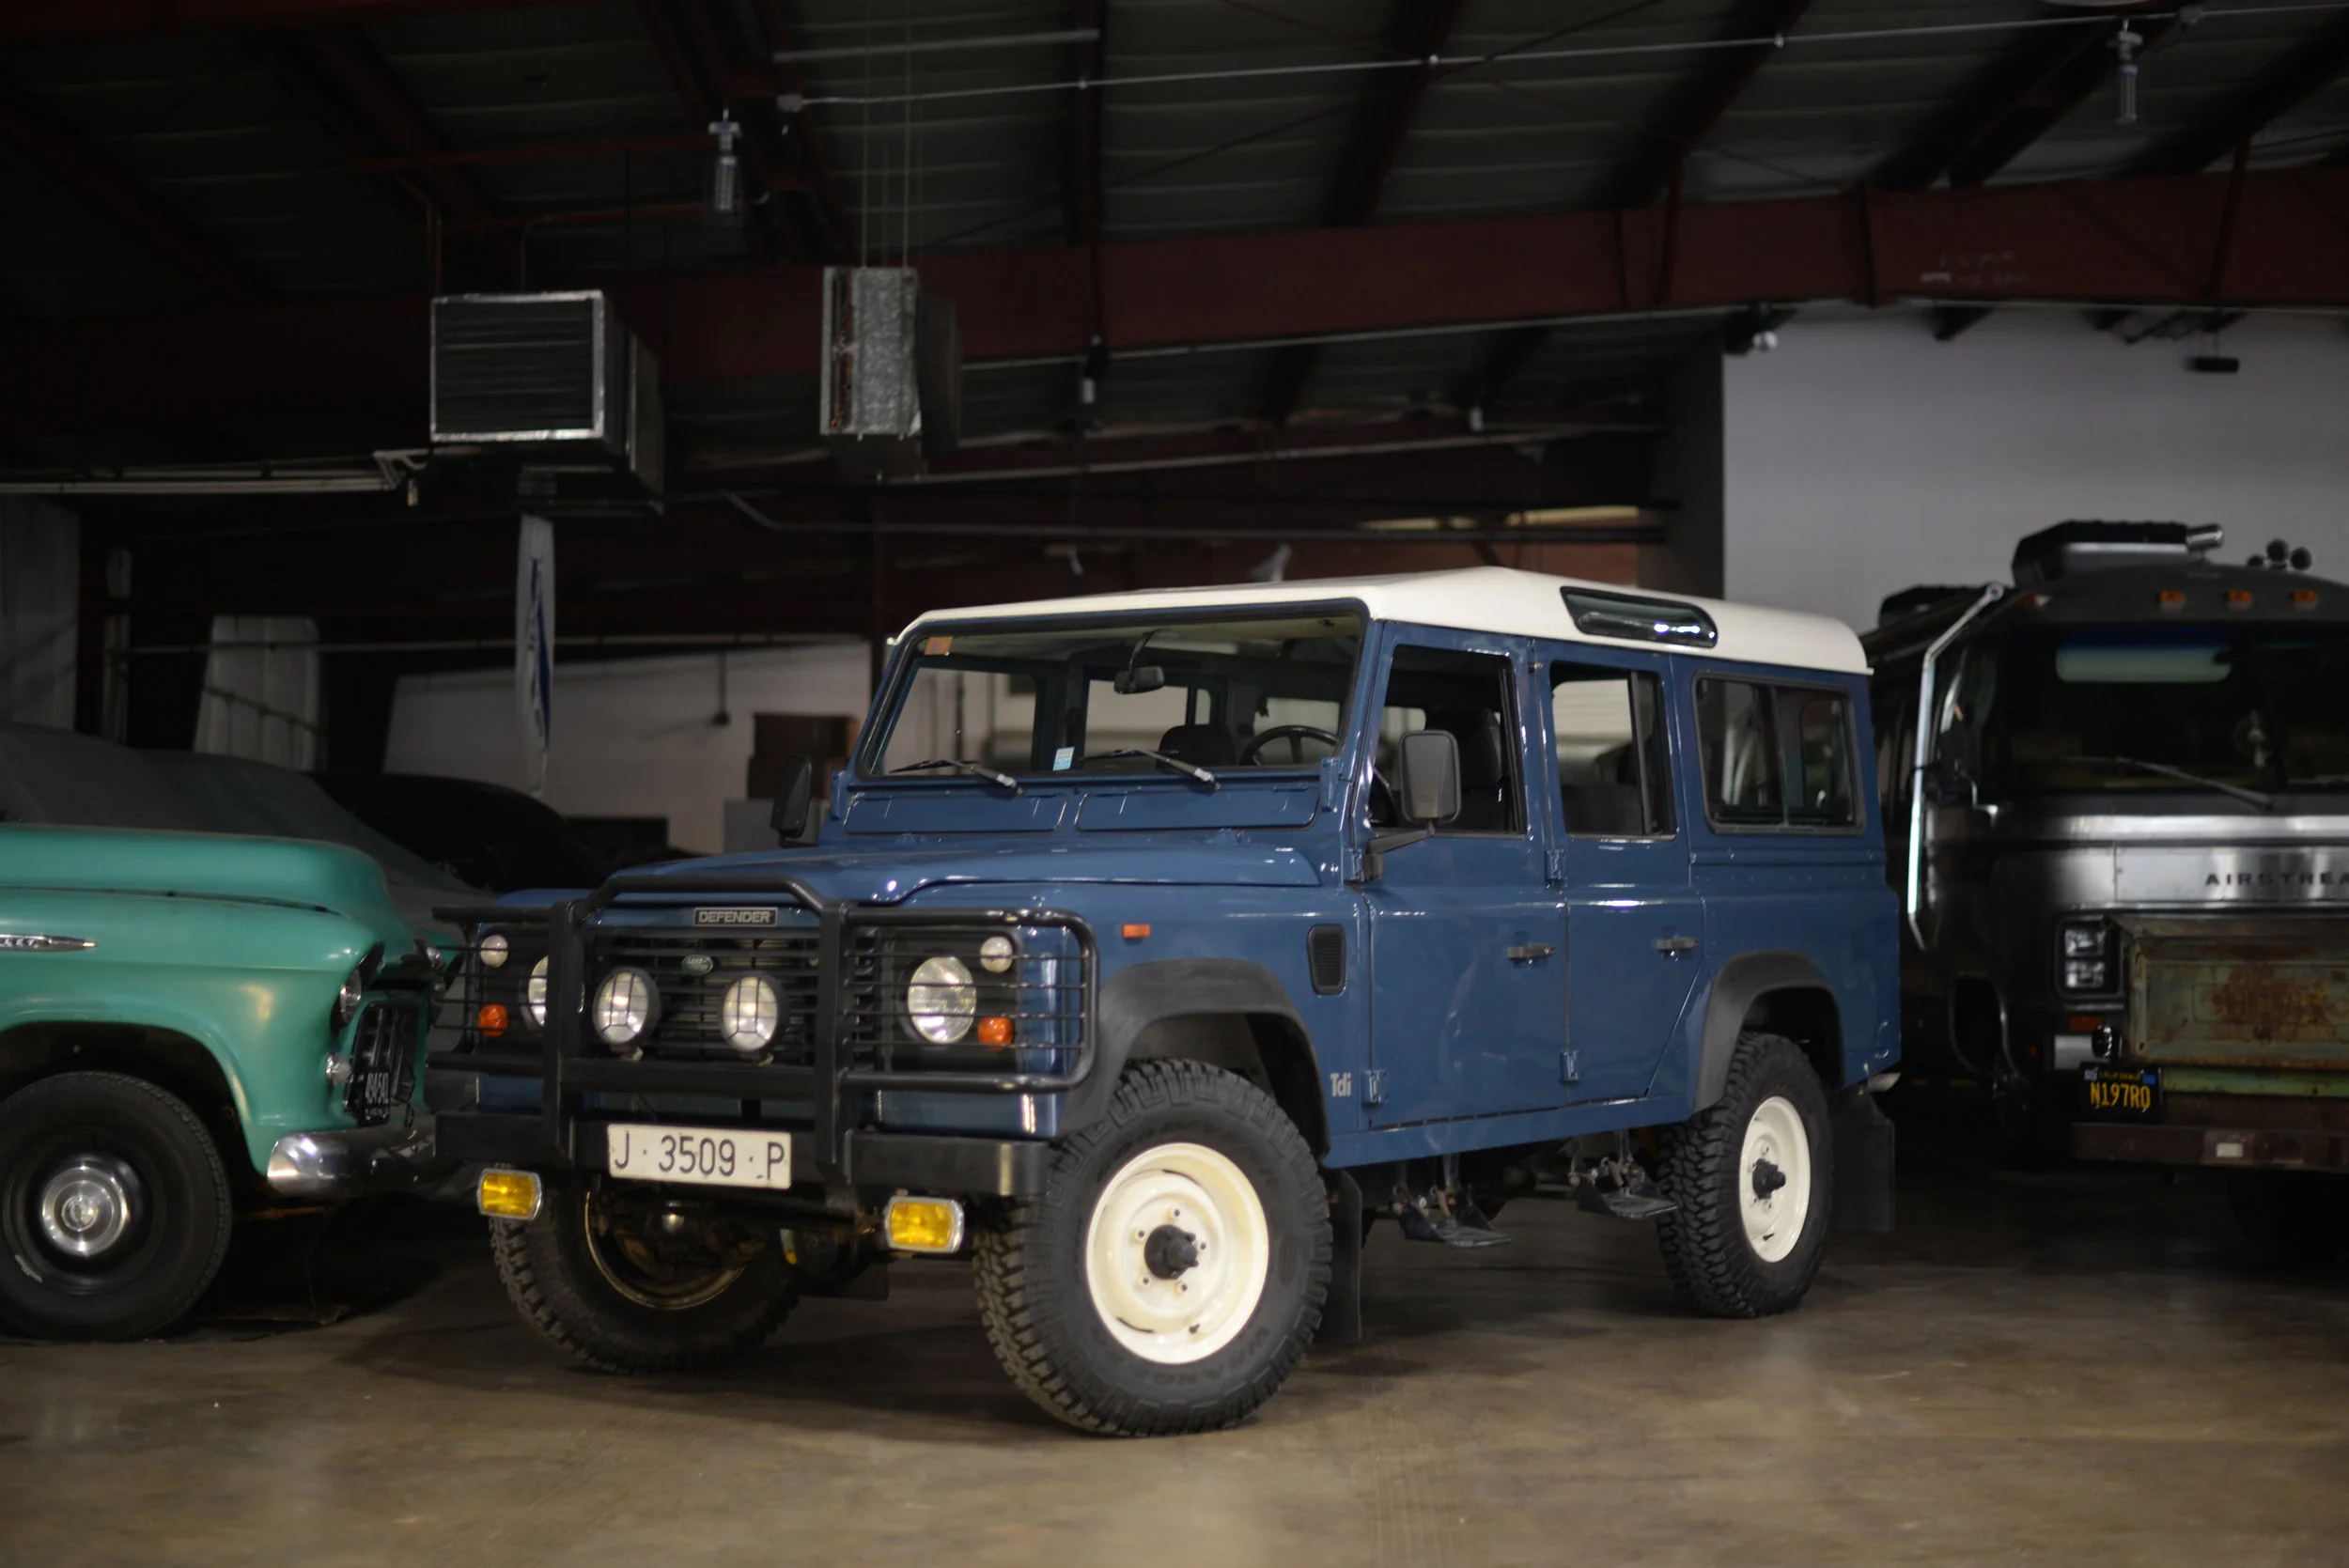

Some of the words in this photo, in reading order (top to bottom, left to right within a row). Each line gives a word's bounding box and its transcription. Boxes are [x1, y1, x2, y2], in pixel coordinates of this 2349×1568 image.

[698, 909, 770, 924] DEFENDER
[1330, 1072, 1352, 1097] Tdi
[614, 1130, 630, 1168] J
[660, 1134, 736, 1176] 3509
[767, 1141, 786, 1180] P
